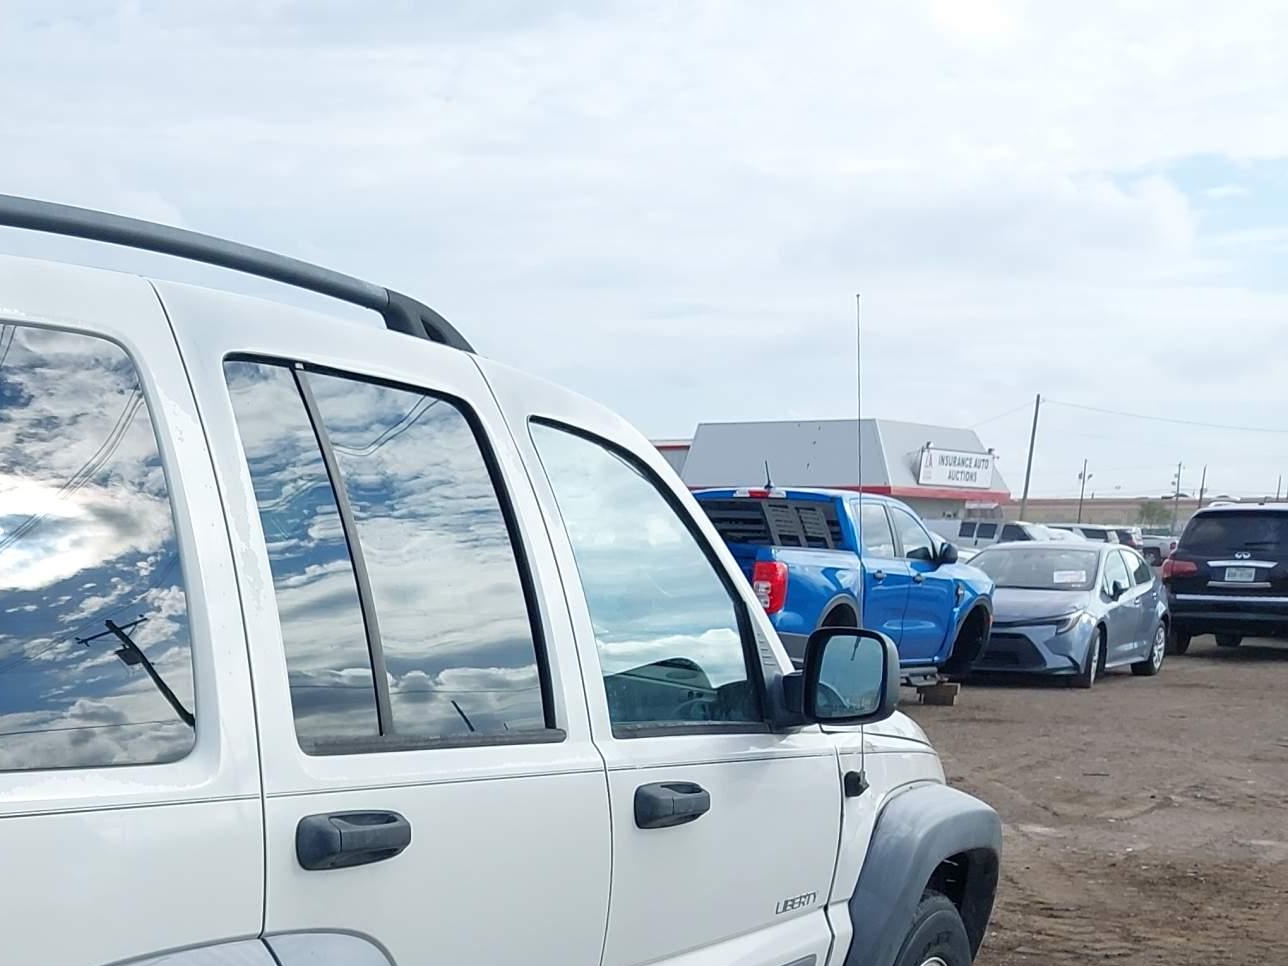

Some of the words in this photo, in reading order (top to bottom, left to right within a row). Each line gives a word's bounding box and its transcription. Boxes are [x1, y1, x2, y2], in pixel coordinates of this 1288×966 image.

[938, 455, 972, 469] INSURANCE
[974, 457, 990, 470] AUTO
[947, 470, 978, 482] AUCTIONS
[775, 892, 817, 914] LIBERTY
